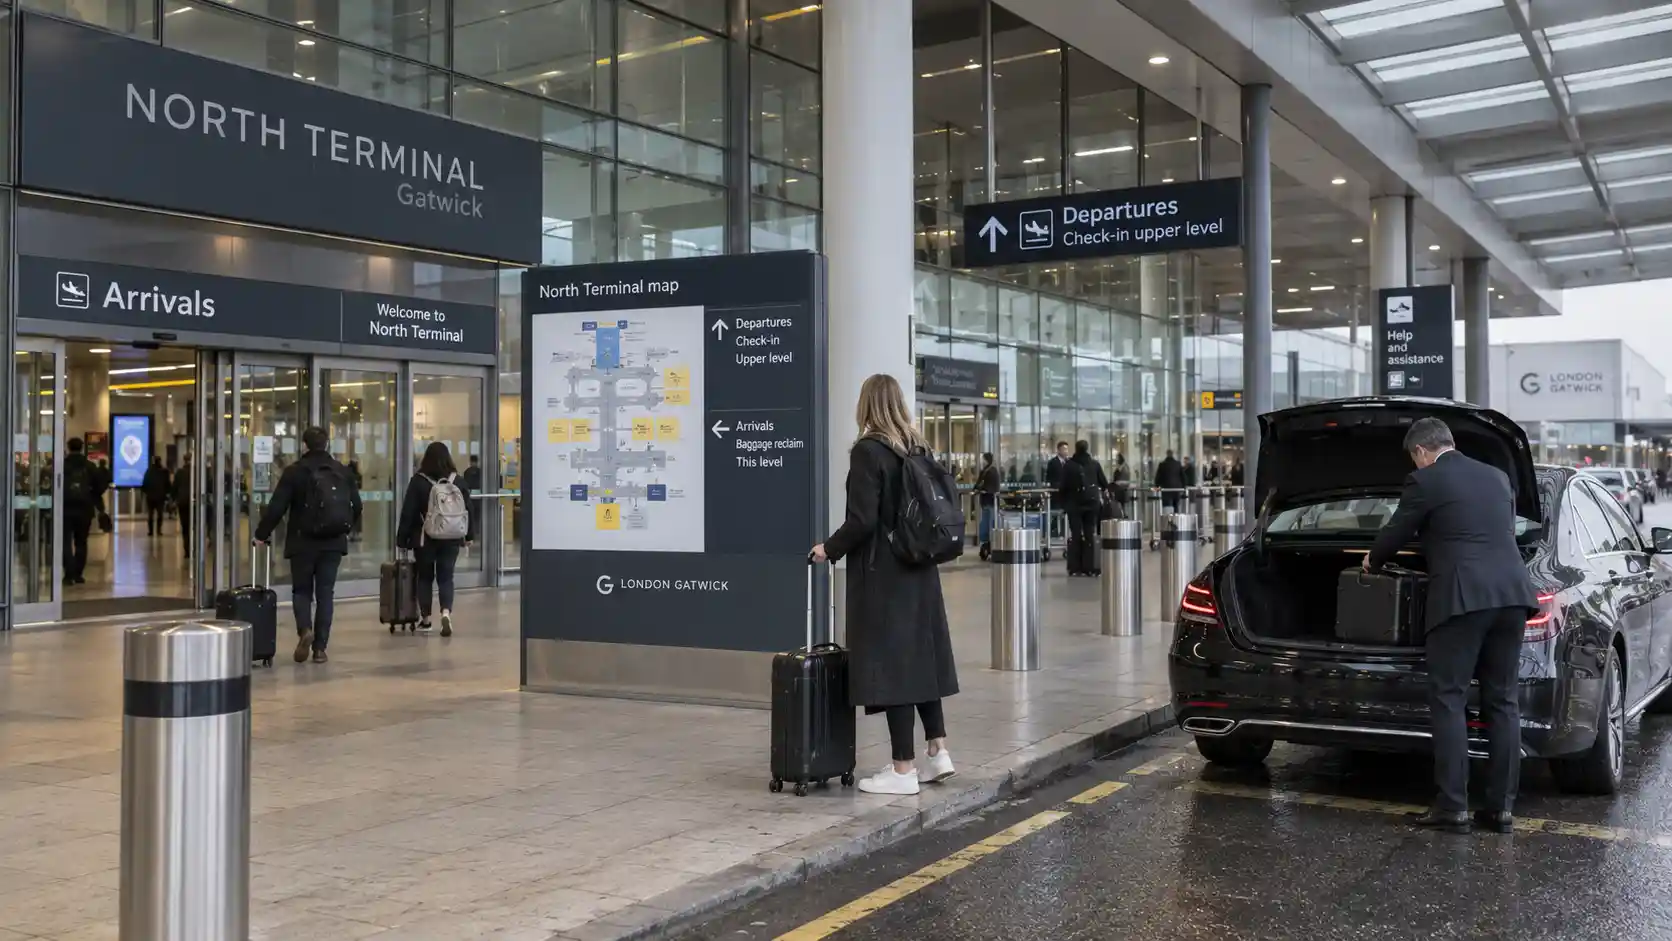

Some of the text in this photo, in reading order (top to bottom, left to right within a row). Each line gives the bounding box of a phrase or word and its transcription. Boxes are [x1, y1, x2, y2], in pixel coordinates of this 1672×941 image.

[127, 84, 484, 190] NORTH TERMINAL
[398, 183, 483, 218] Gatwick
[1064, 201, 1179, 226] Departures
[1064, 218, 1222, 246] Check-in upper level
[540, 280, 679, 298] North Terminal map
[103, 282, 215, 317] Arrivals
[377, 303, 445, 322] Welcome to
[736, 318, 791, 330] Departures
[371, 321, 463, 342] North Terminal
[1387, 330, 1414, 342] Help
[736, 335, 779, 346] Check-in
[1388, 342, 1409, 353] and
[736, 352, 792, 366] Upper level
[1388, 354, 1445, 365] assistance
[1550, 373, 1603, 382] LONDON
[736, 421, 773, 431] Arrivals
[736, 438, 803, 451] Baggage reclaim
[736, 456, 782, 467] This level
[621, 579, 669, 589] LONDON
[675, 580, 728, 590] GATWICK
